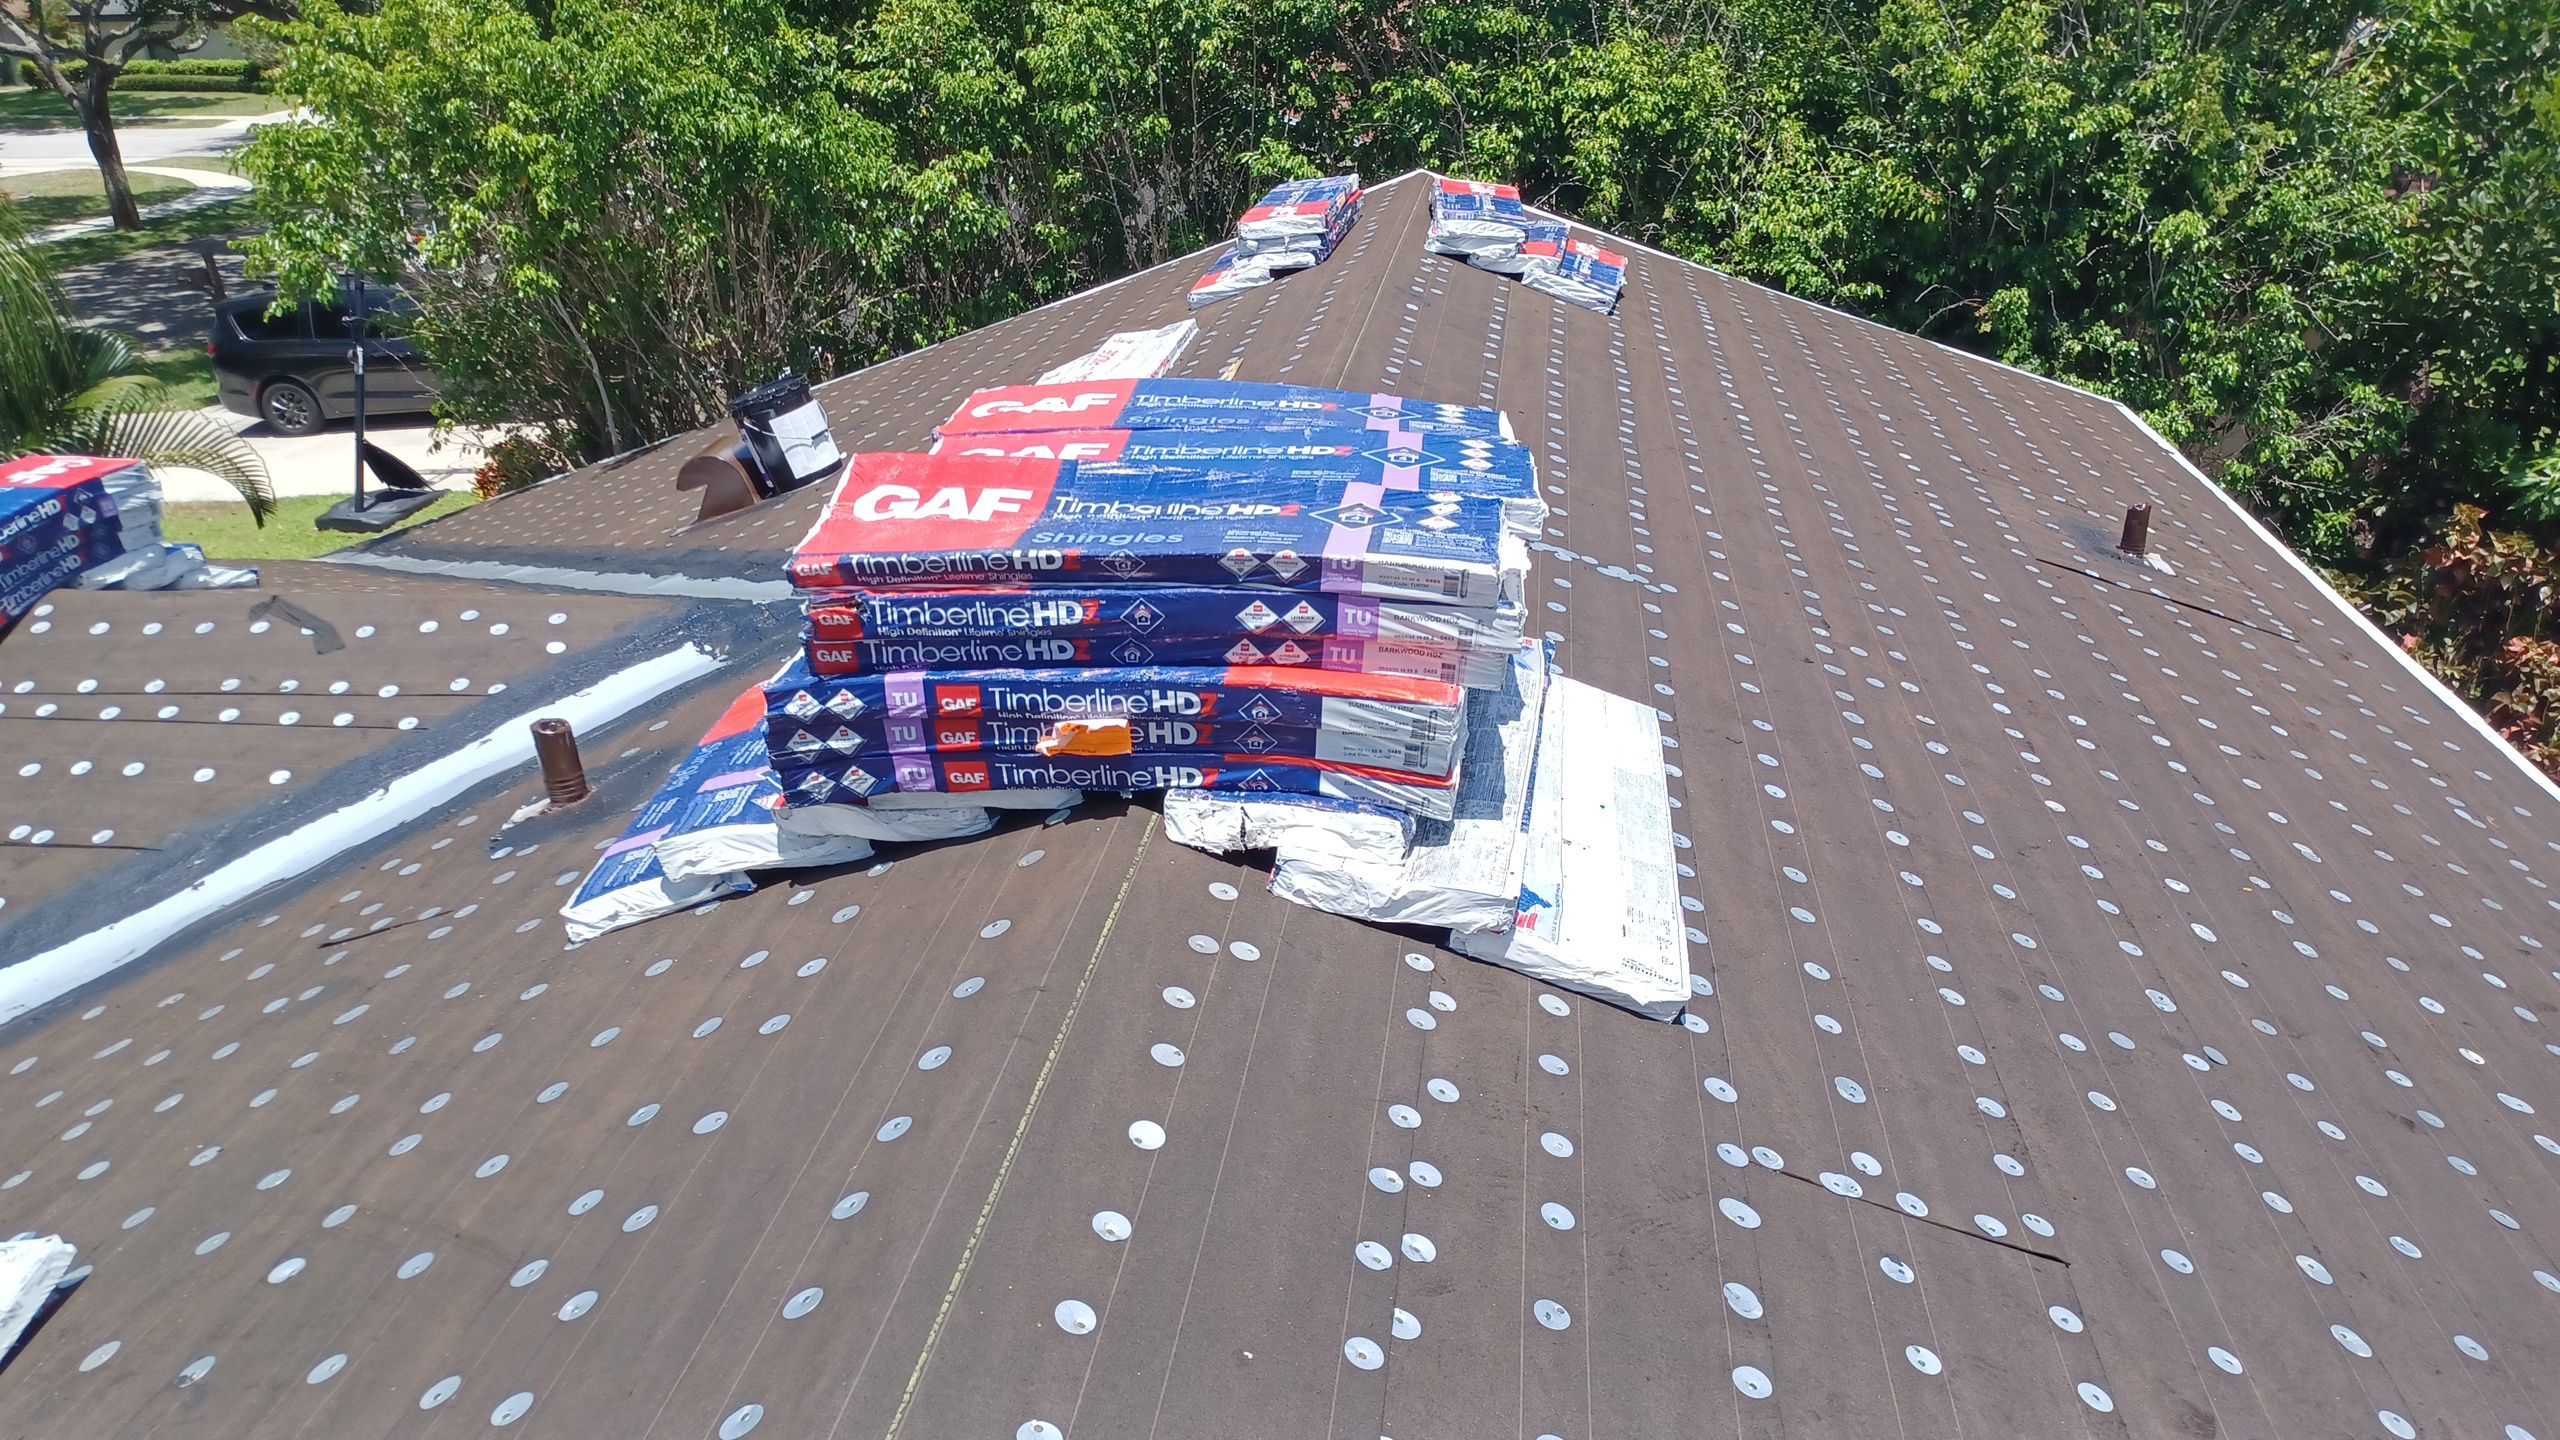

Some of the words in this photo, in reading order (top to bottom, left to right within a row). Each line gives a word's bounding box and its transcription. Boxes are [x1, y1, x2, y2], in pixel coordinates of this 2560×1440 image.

[970, 392, 1118, 418] GAF
[1136, 394, 1276, 407] Timberline
[1129, 445, 1284, 456] Timberline
[852, 484, 1034, 522] GAF
[1031, 531, 1184, 547] Shingles
[799, 562, 834, 577] GAF
[851, 553, 1010, 576] Timberline
[1012, 549, 1083, 571] HDZ
[857, 574, 884, 585] High
[988, 570, 1034, 583] Shingles
[819, 613, 856, 627] GAF
[869, 600, 1031, 627] Timberline
[1033, 600, 1099, 627] HDZ
[1344, 608, 1372, 626] TU
[1393, 614, 1442, 623] BARKWOOD
[1443, 617, 1461, 625] HDZ
[877, 627, 905, 639] High
[907, 627, 961, 637] Definition
[816, 650, 852, 663] GAF
[862, 639, 1022, 664] Timberline
[1025, 639, 1092, 662] HDZ
[1329, 646, 1357, 665] TU
[1378, 646, 1425, 656] BARKWOOD
[892, 691, 918, 707] TU
[940, 697, 977, 711] GAF
[988, 688, 1148, 714] Timberline
[1151, 689, 1219, 716] HDZ
[890, 726, 917, 741] TU
[940, 731, 976, 745] GAF
[1148, 721, 1215, 746] HDZ
[901, 767, 926, 782] TU
[950, 772, 985, 785] GAF
[995, 763, 1151, 786] Timberline
[1154, 766, 1219, 788] HDZ
